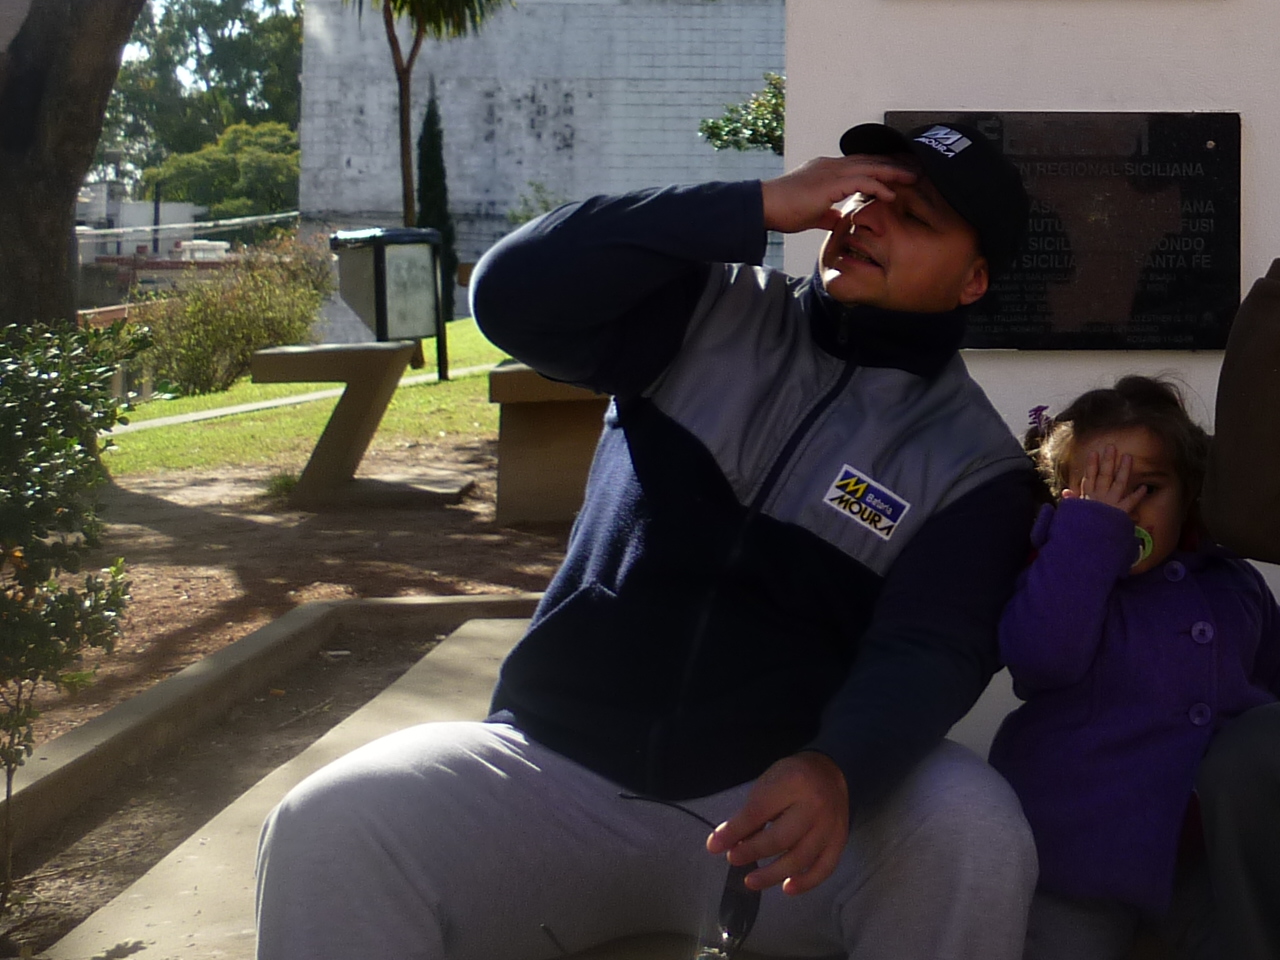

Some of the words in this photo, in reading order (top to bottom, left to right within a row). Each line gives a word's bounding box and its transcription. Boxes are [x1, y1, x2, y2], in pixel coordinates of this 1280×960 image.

[1037, 162, 1120, 177] REGIONAL
[1124, 162, 1205, 177] SICILIANA
[1192, 255, 1212, 269] FE
[829, 494, 896, 536] MOURA
